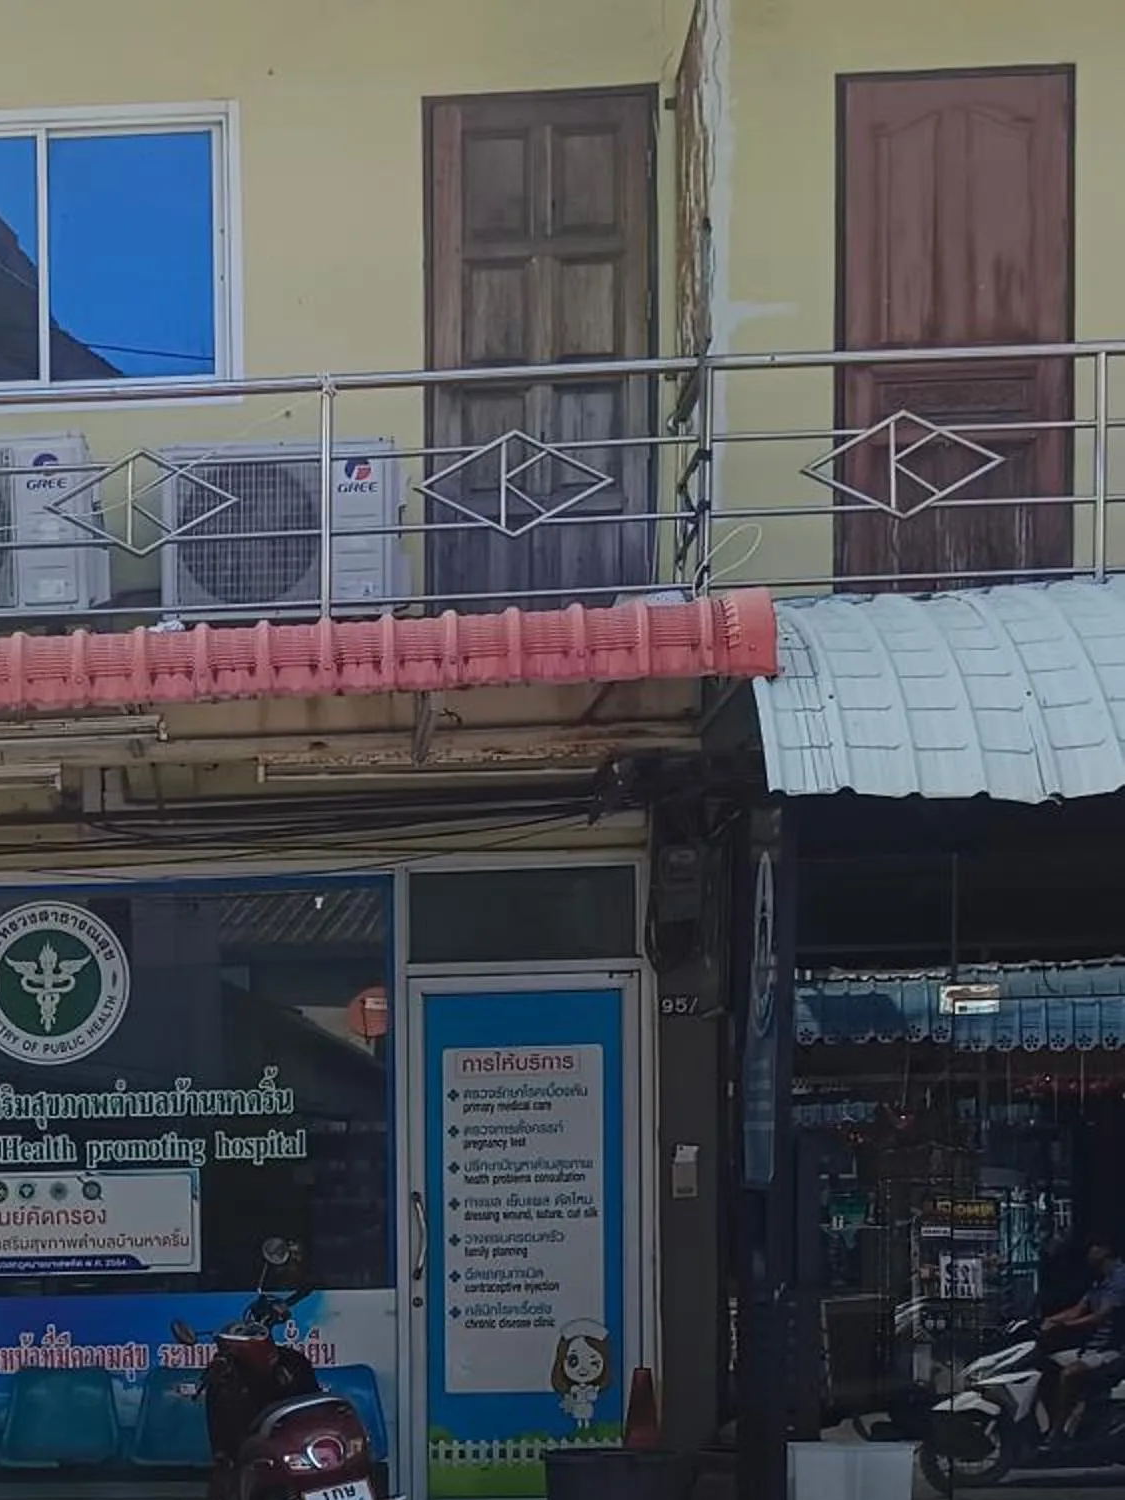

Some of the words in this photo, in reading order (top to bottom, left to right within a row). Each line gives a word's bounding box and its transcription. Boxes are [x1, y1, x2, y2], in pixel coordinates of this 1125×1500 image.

[25, 477, 68, 491] GREE
[336, 480, 379, 493] GREE
[22, 1039, 39, 1053] OF
[42, 1037, 86, 1055] PUBLIC
[87, 995, 117, 1038] HEALTH
[462, 1052, 574, 1072] การให้บริการ
[86, 1131, 207, 1168] promoting
[215, 1128, 307, 1165] hospital
